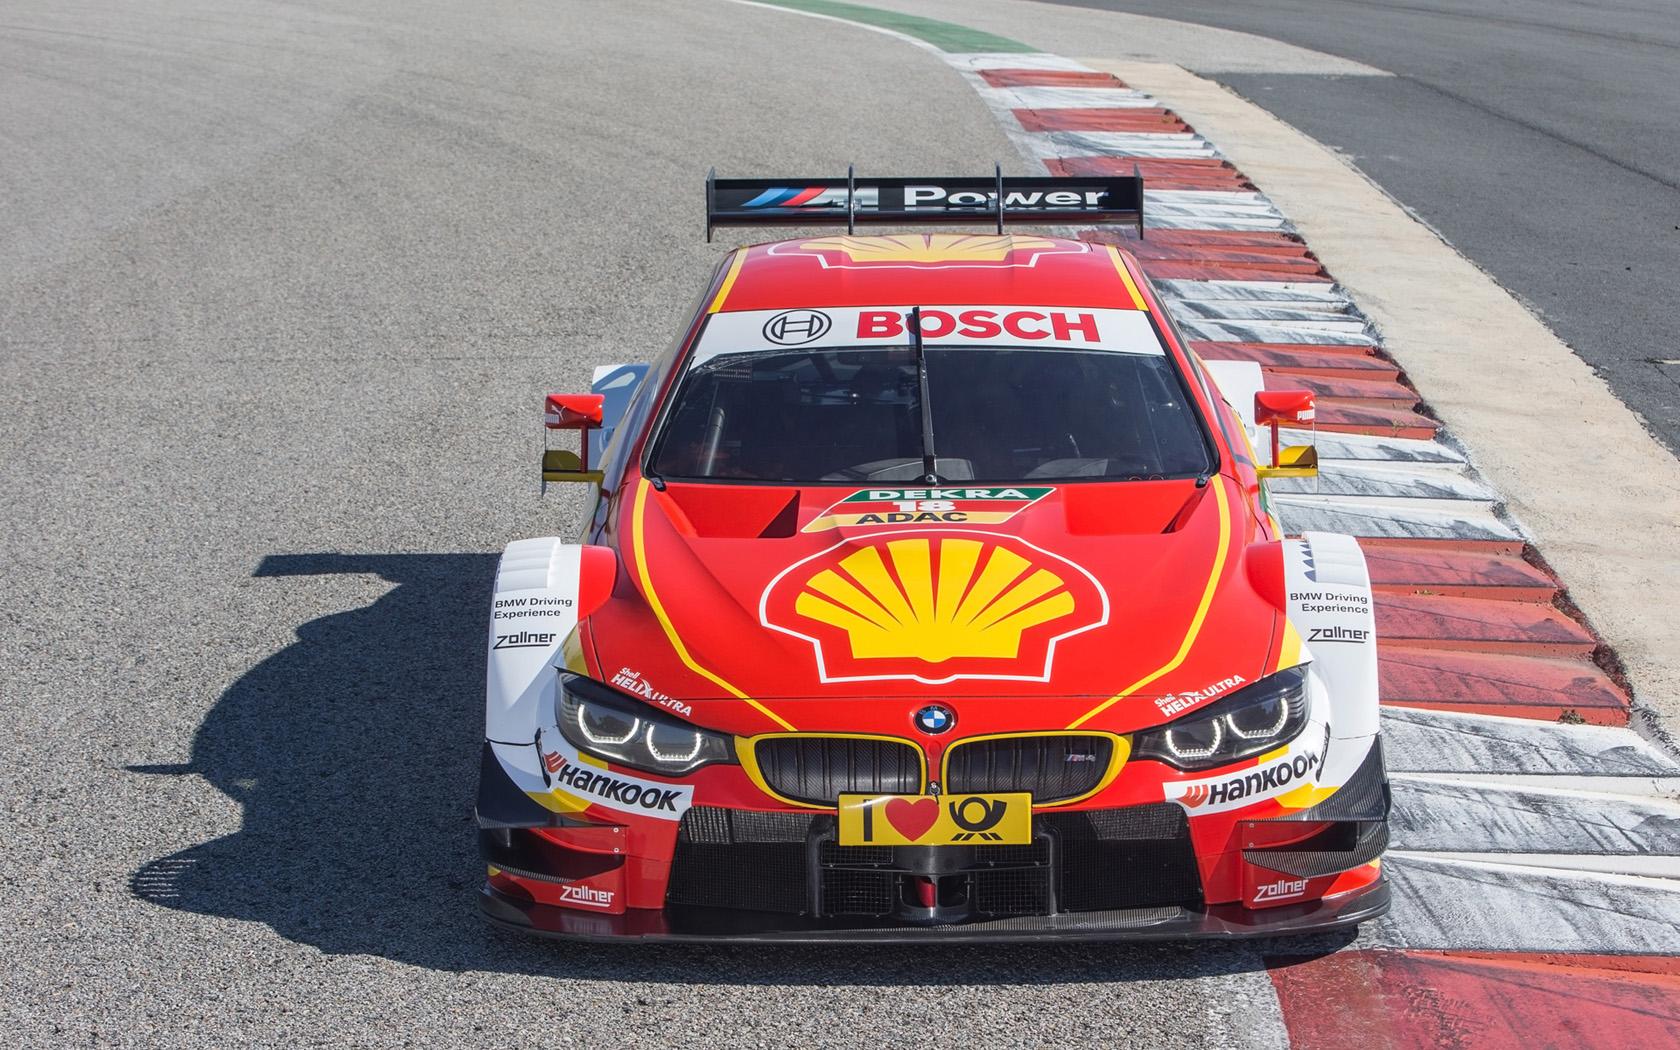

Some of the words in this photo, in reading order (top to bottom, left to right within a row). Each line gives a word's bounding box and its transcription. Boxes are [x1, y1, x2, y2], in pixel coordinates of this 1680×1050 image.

[903, 184, 1108, 206] Power
[857, 309, 1101, 343] BOSCH
[869, 489, 1028, 500] DEKRA
[893, 501, 956, 512] 18
[856, 513, 968, 524] ADAC
[495, 598, 528, 608] BMW
[530, 597, 573, 608] Driving
[1290, 592, 1322, 602] BMW
[1325, 592, 1368, 604] Driving
[494, 608, 561, 619] Experience
[1301, 603, 1369, 614] Experience
[619, 667, 641, 680] Shell
[611, 674, 654, 700] HELIX
[1154, 693, 1176, 708] Shell
[1160, 691, 1208, 718] HELIX
[1203, 674, 1246, 698] ULTRA
[863, 798, 873, 842] I
